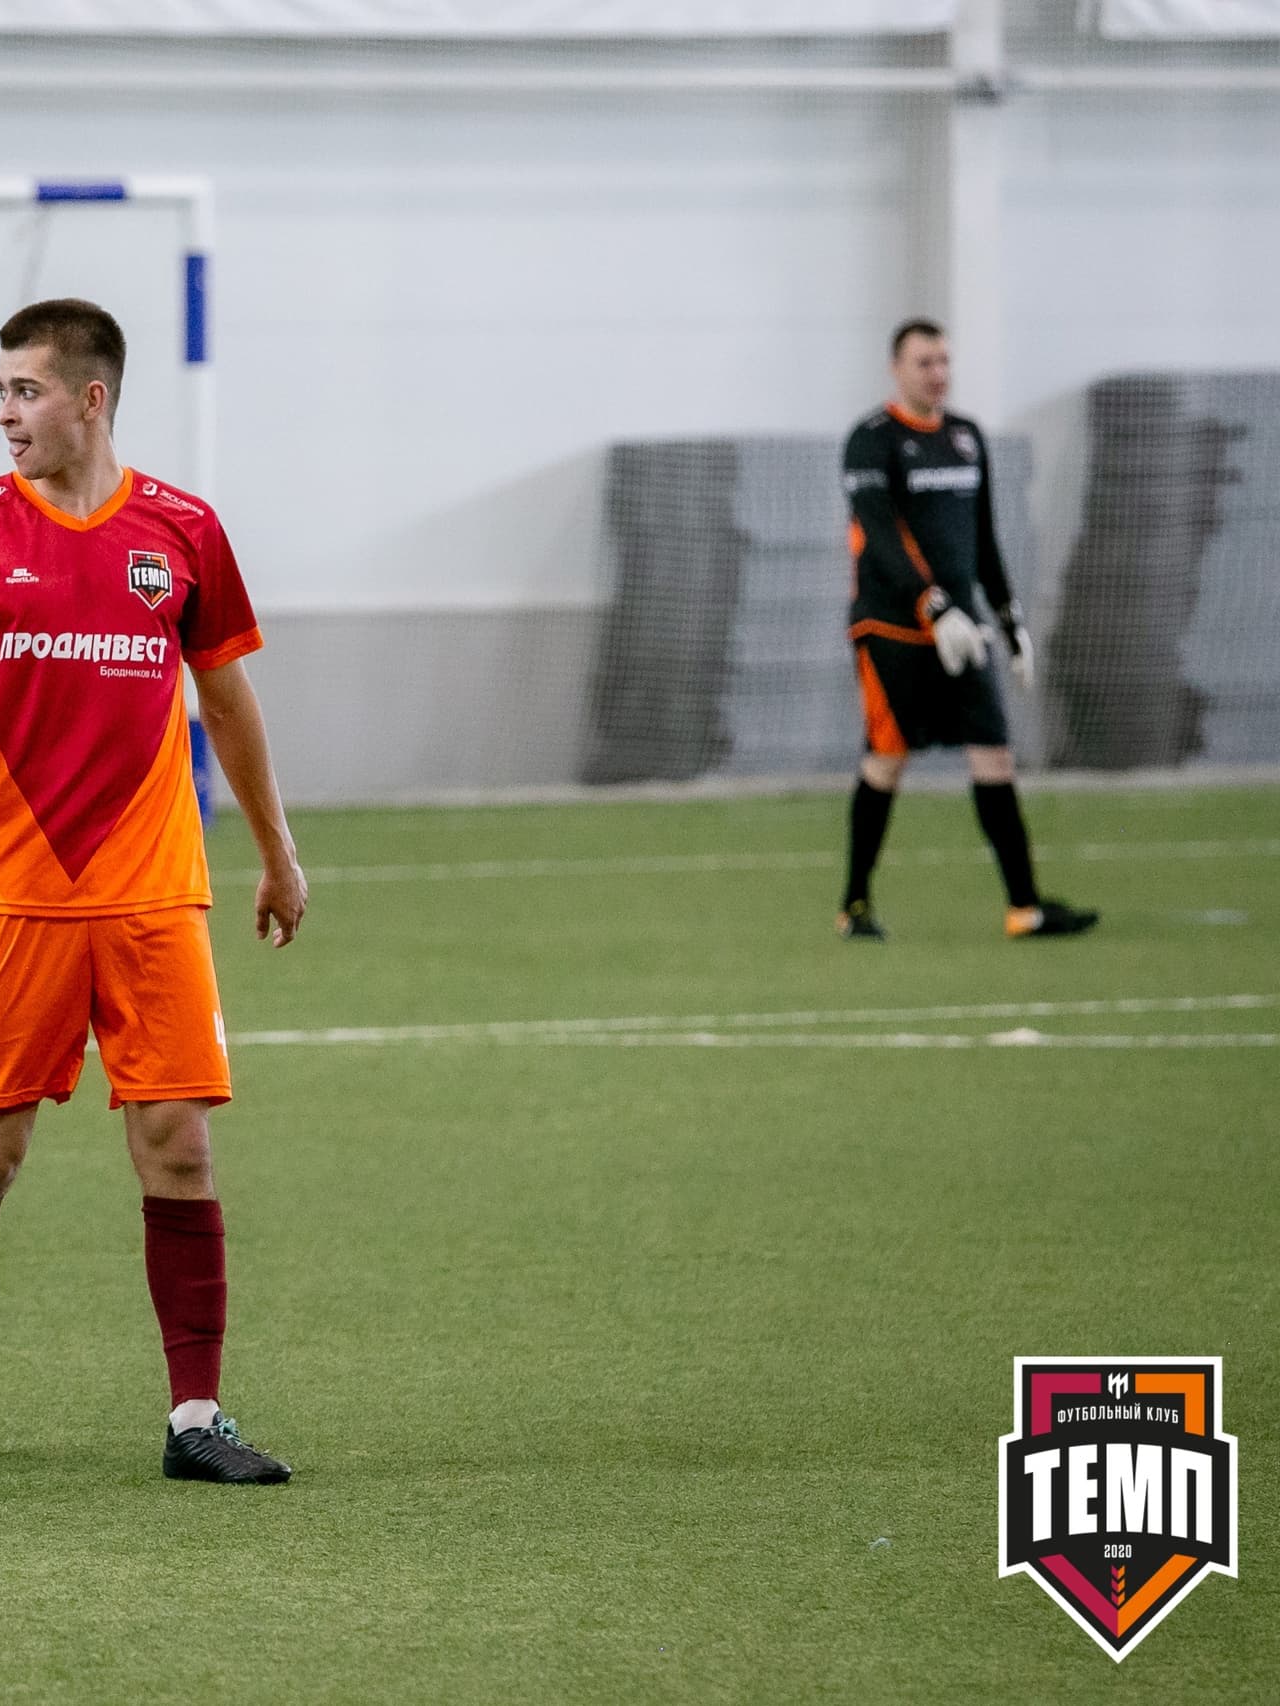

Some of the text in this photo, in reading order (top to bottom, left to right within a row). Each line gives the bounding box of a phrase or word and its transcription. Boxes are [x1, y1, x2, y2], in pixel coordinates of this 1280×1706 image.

[132, 566, 169, 590] ТЕМП
[0, 632, 168, 664] ПРОДИНВЕСТ
[100, 665, 150, 679] Бродников
